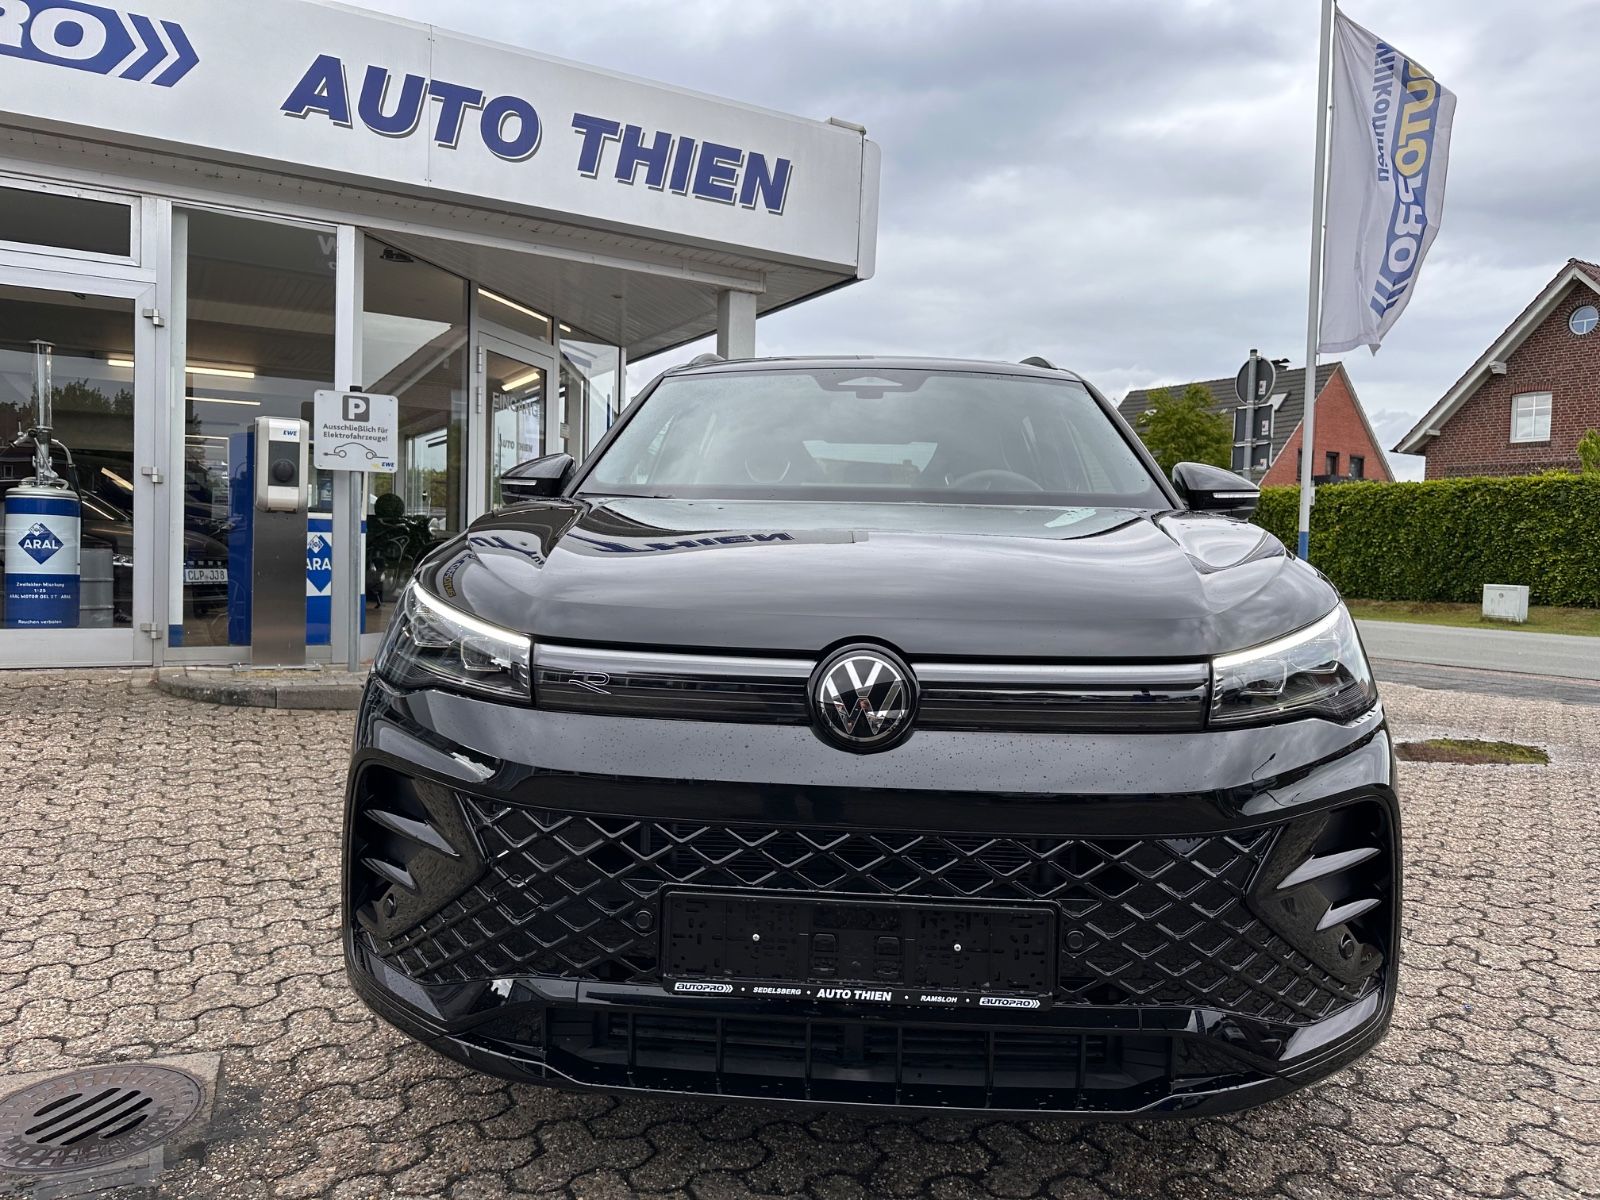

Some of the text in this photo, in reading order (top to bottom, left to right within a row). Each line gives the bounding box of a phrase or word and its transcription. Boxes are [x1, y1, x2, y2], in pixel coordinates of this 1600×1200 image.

[280, 54, 793, 215] AUTO THIEN
[348, 398, 366, 419] P
[323, 424, 376, 433] Ausschließlich
[323, 432, 388, 442] Elektrofahrzeuge!
[23, 540, 59, 549] ARAL
[753, 986, 801, 995] SEDELSBERG
[817, 988, 852, 999] AUTO
[854, 990, 892, 1001] THIEN
[920, 995, 958, 1003] RAMSLOH
